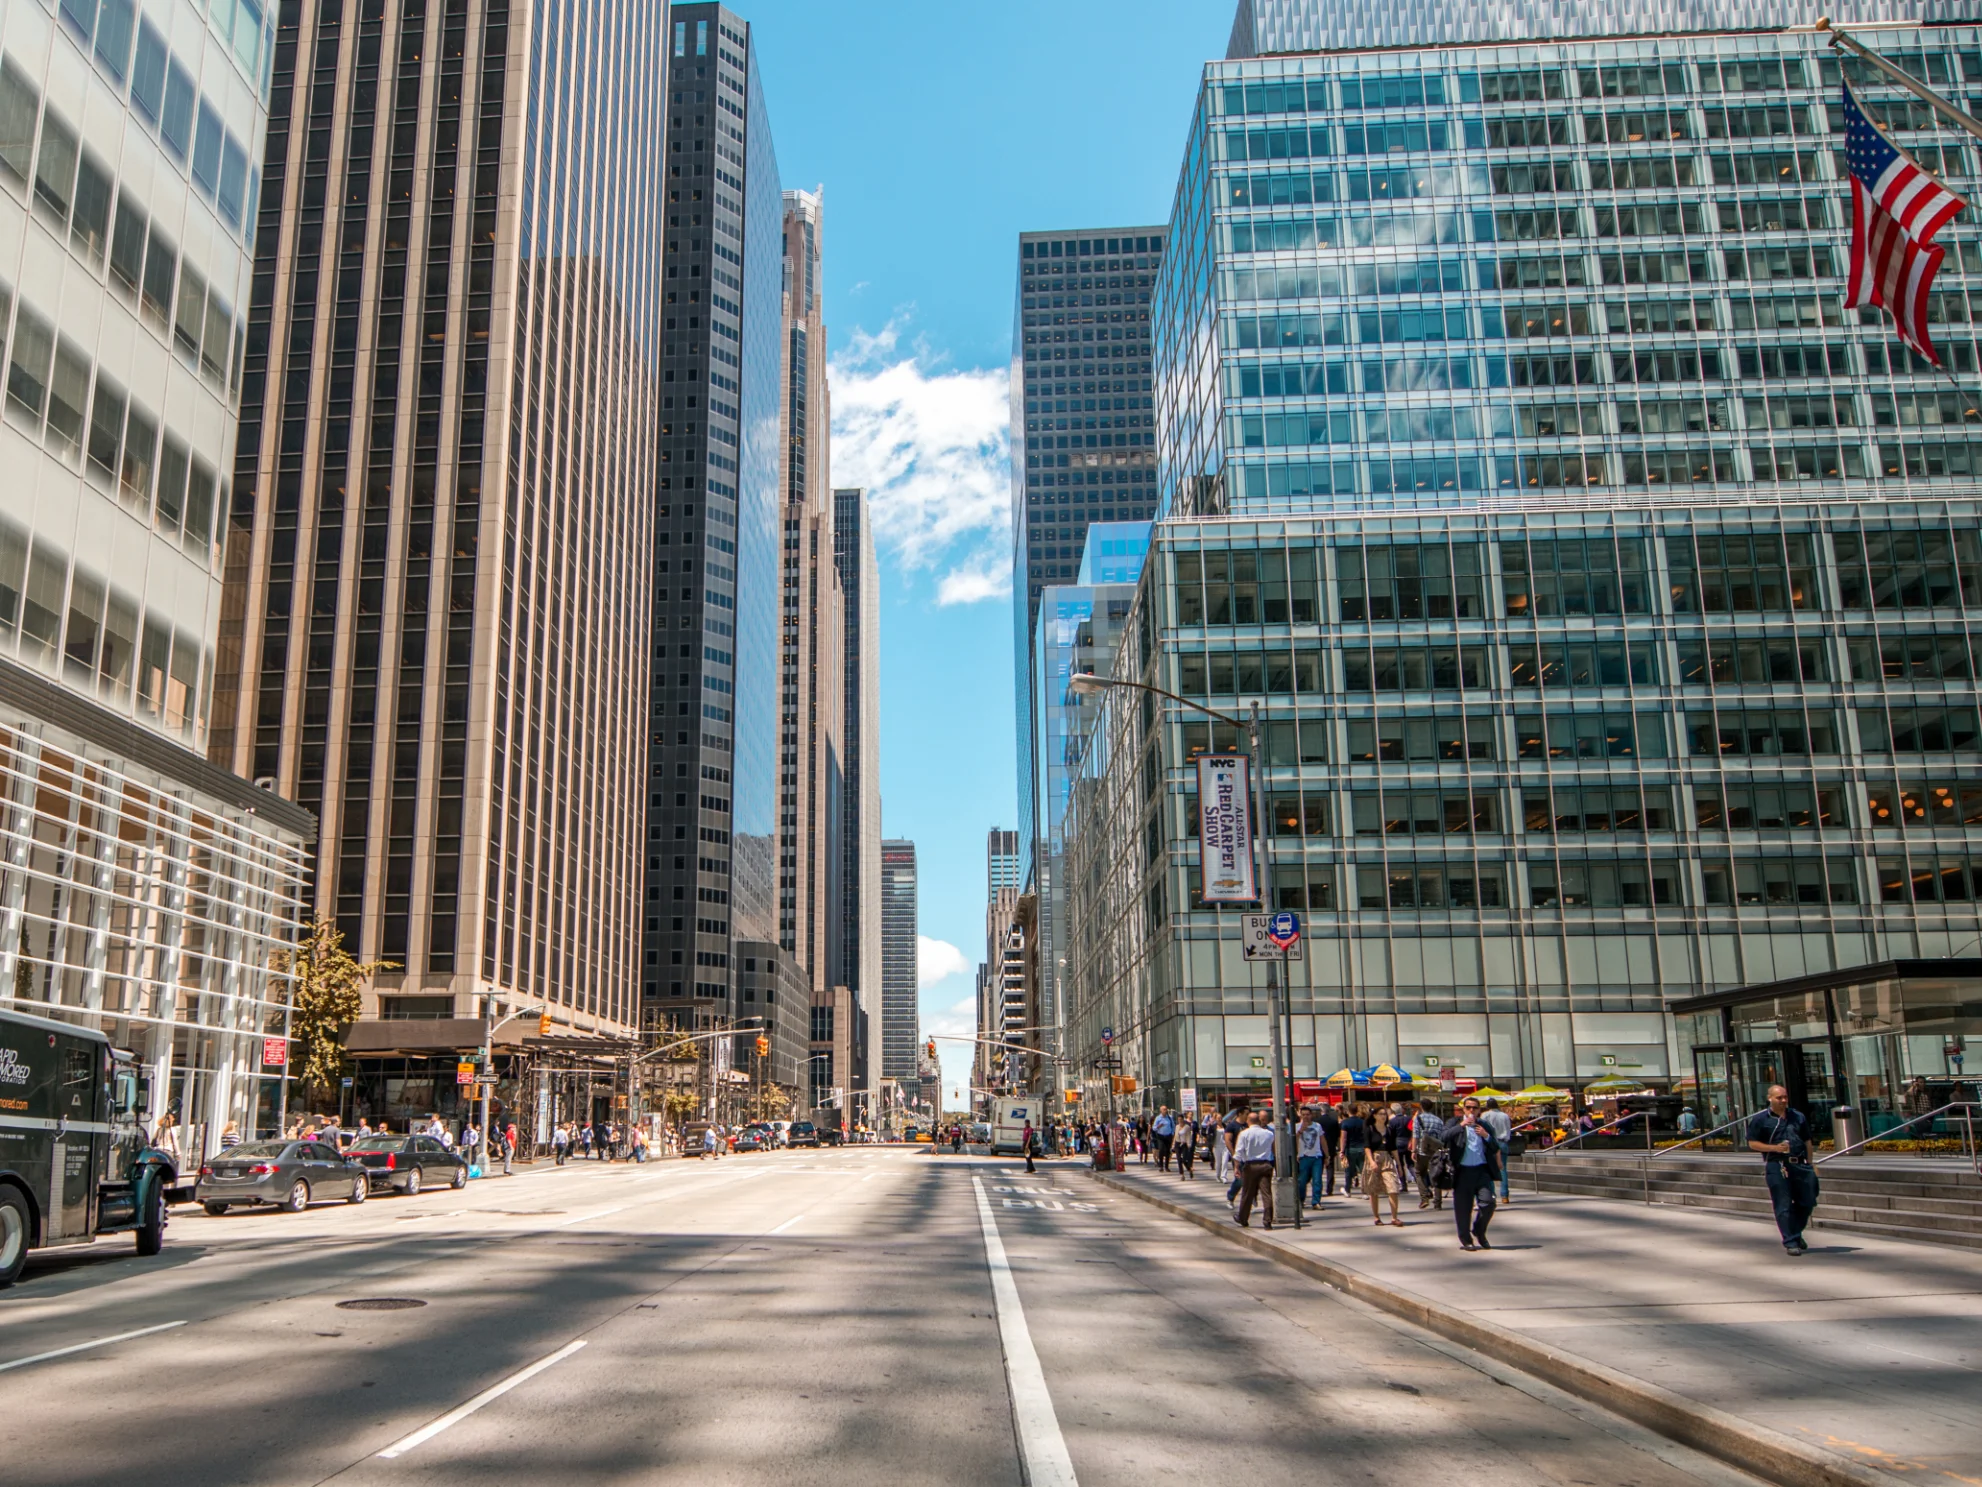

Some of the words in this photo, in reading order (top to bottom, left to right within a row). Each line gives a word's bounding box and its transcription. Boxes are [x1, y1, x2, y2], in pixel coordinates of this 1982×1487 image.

[1210, 759, 1235, 768] NYC
[1218, 784, 1233, 812] RED
[1205, 806, 1219, 848] SHOW
[1220, 814, 1235, 870] CARPET
[1252, 1058, 1264, 1067] TD
[1426, 1056, 1438, 1066] TD
[1603, 1056, 1615, 1065] TD
[992, 1185, 1077, 1196] ONLY
[1002, 1198, 1100, 1213] BUS
